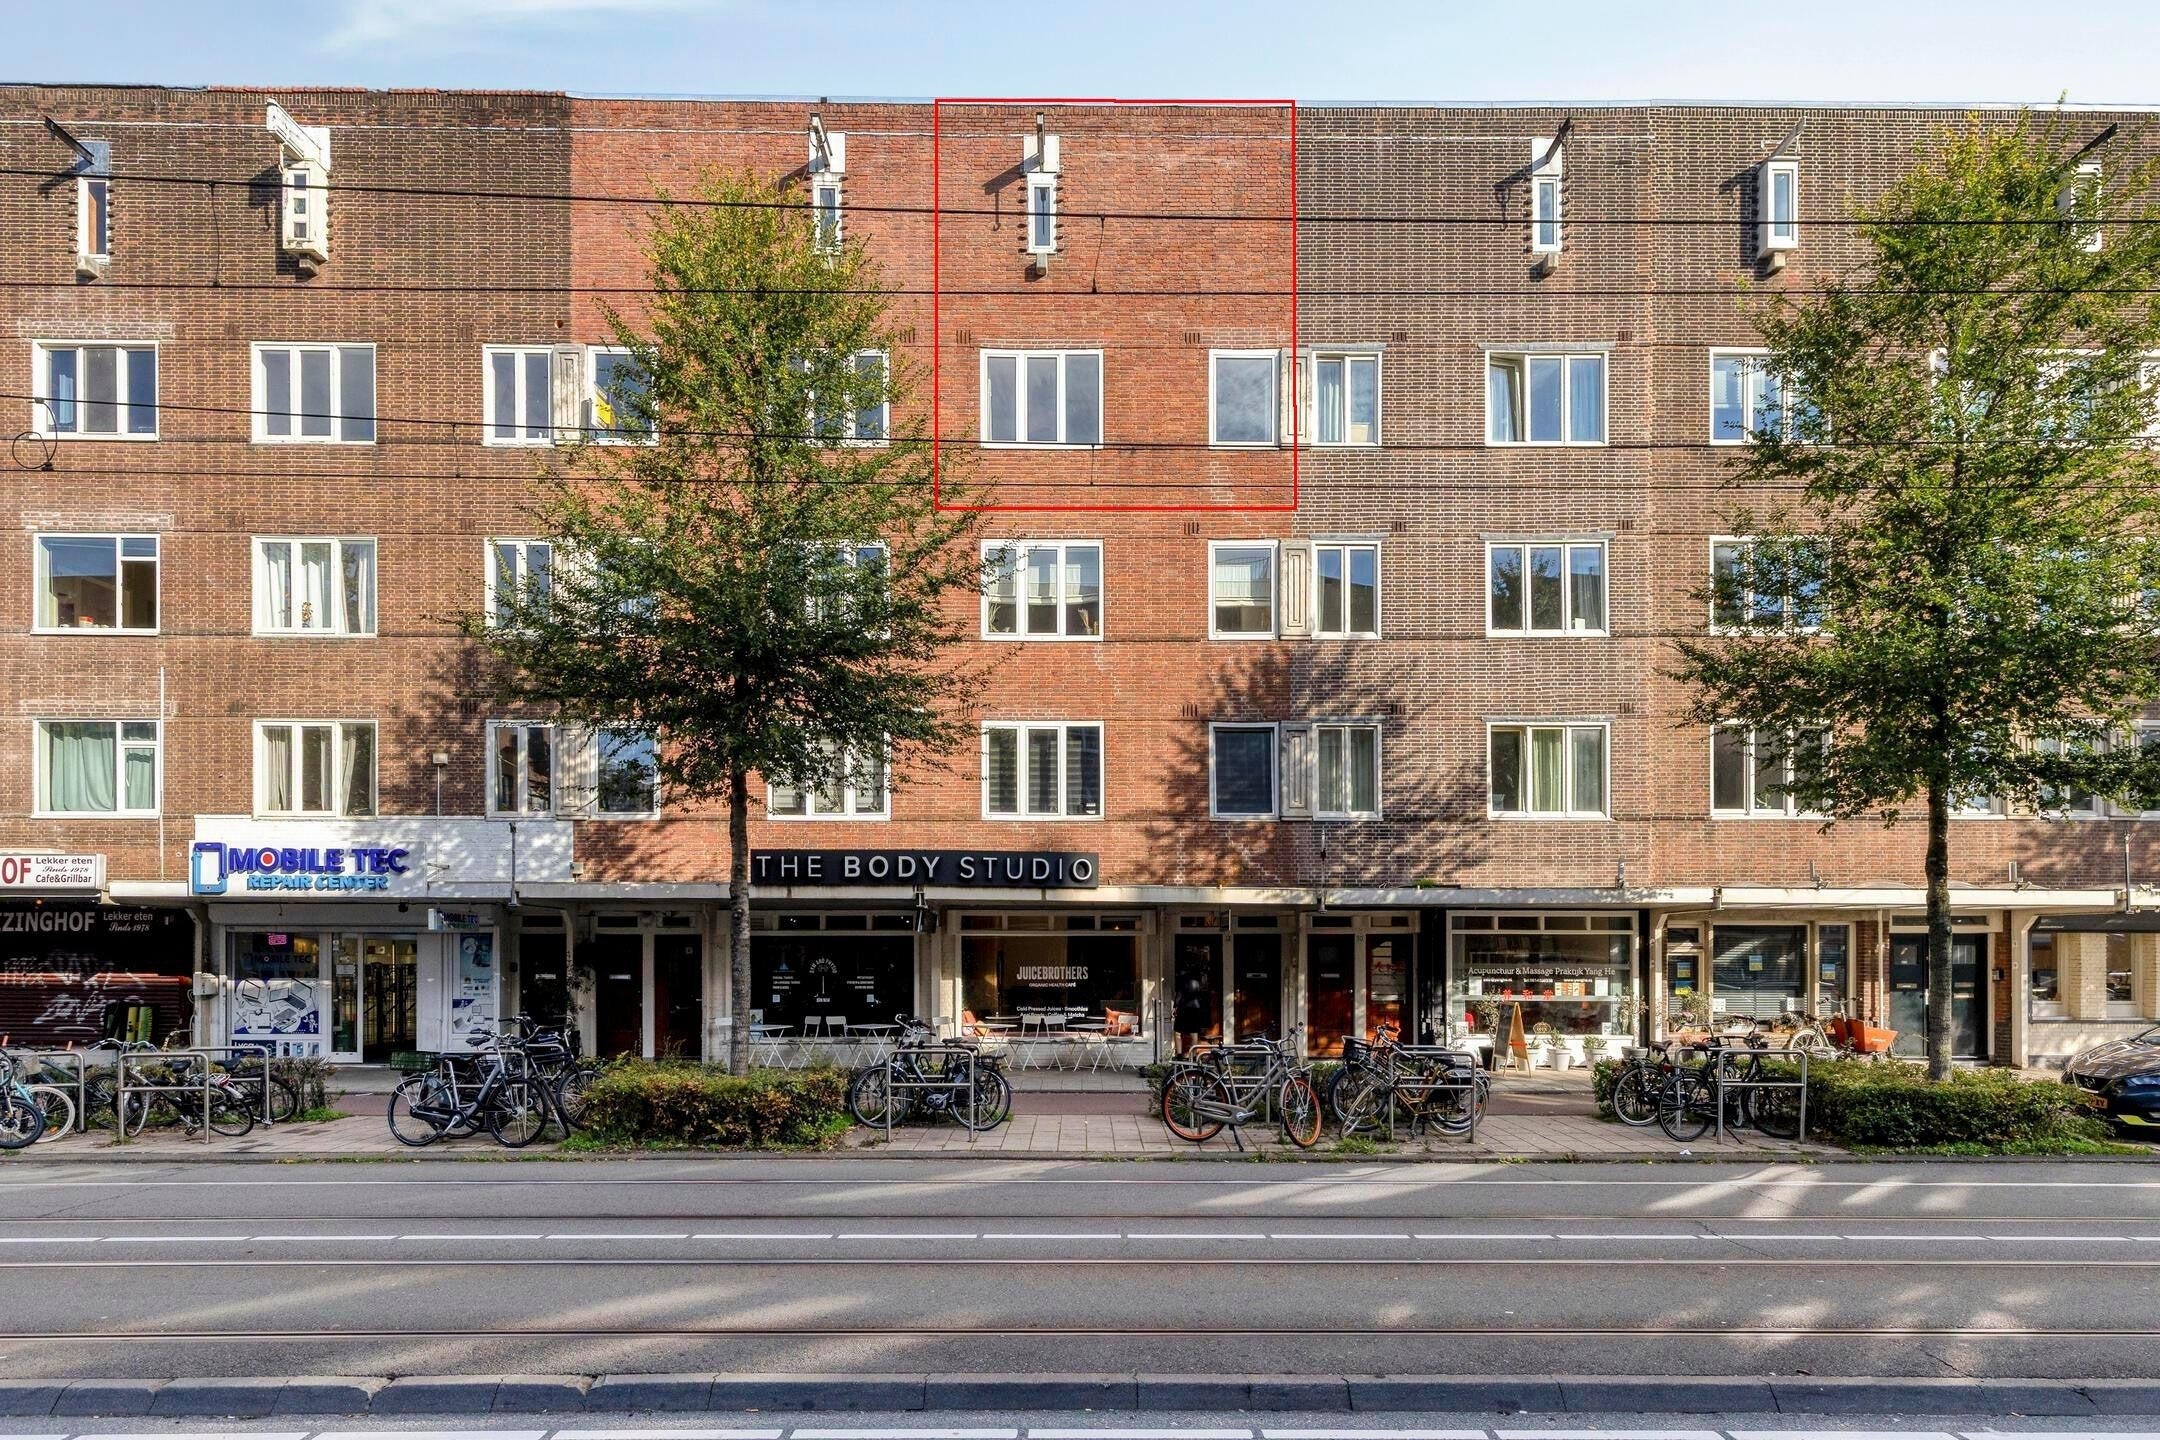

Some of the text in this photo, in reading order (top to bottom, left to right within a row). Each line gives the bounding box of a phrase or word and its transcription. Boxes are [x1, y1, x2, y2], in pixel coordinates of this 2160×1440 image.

[36, 857, 93, 865] Lekker eten
[228, 847, 410, 874] MOBILE TEC
[2, 857, 31, 884] OF
[756, 855, 1093, 881] THE BODY STUDIO
[35, 875, 92, 883] Cafe&Grillbar
[247, 874, 389, 891] REPAIR CENTER
[0, 912, 95, 932] ZINGHOF
[103, 912, 153, 921] Lekker eten
[133, 922, 150, 932] 1978
[1017, 966, 1088, 980] JUICEBROTHERS
[1468, 967, 1514, 976] Acupunctuur
[1516, 967, 1521, 975] &
[1522, 967, 1553, 976] Massage
[1585, 967, 1603, 976] Yang
[1604, 967, 1616, 975] He
